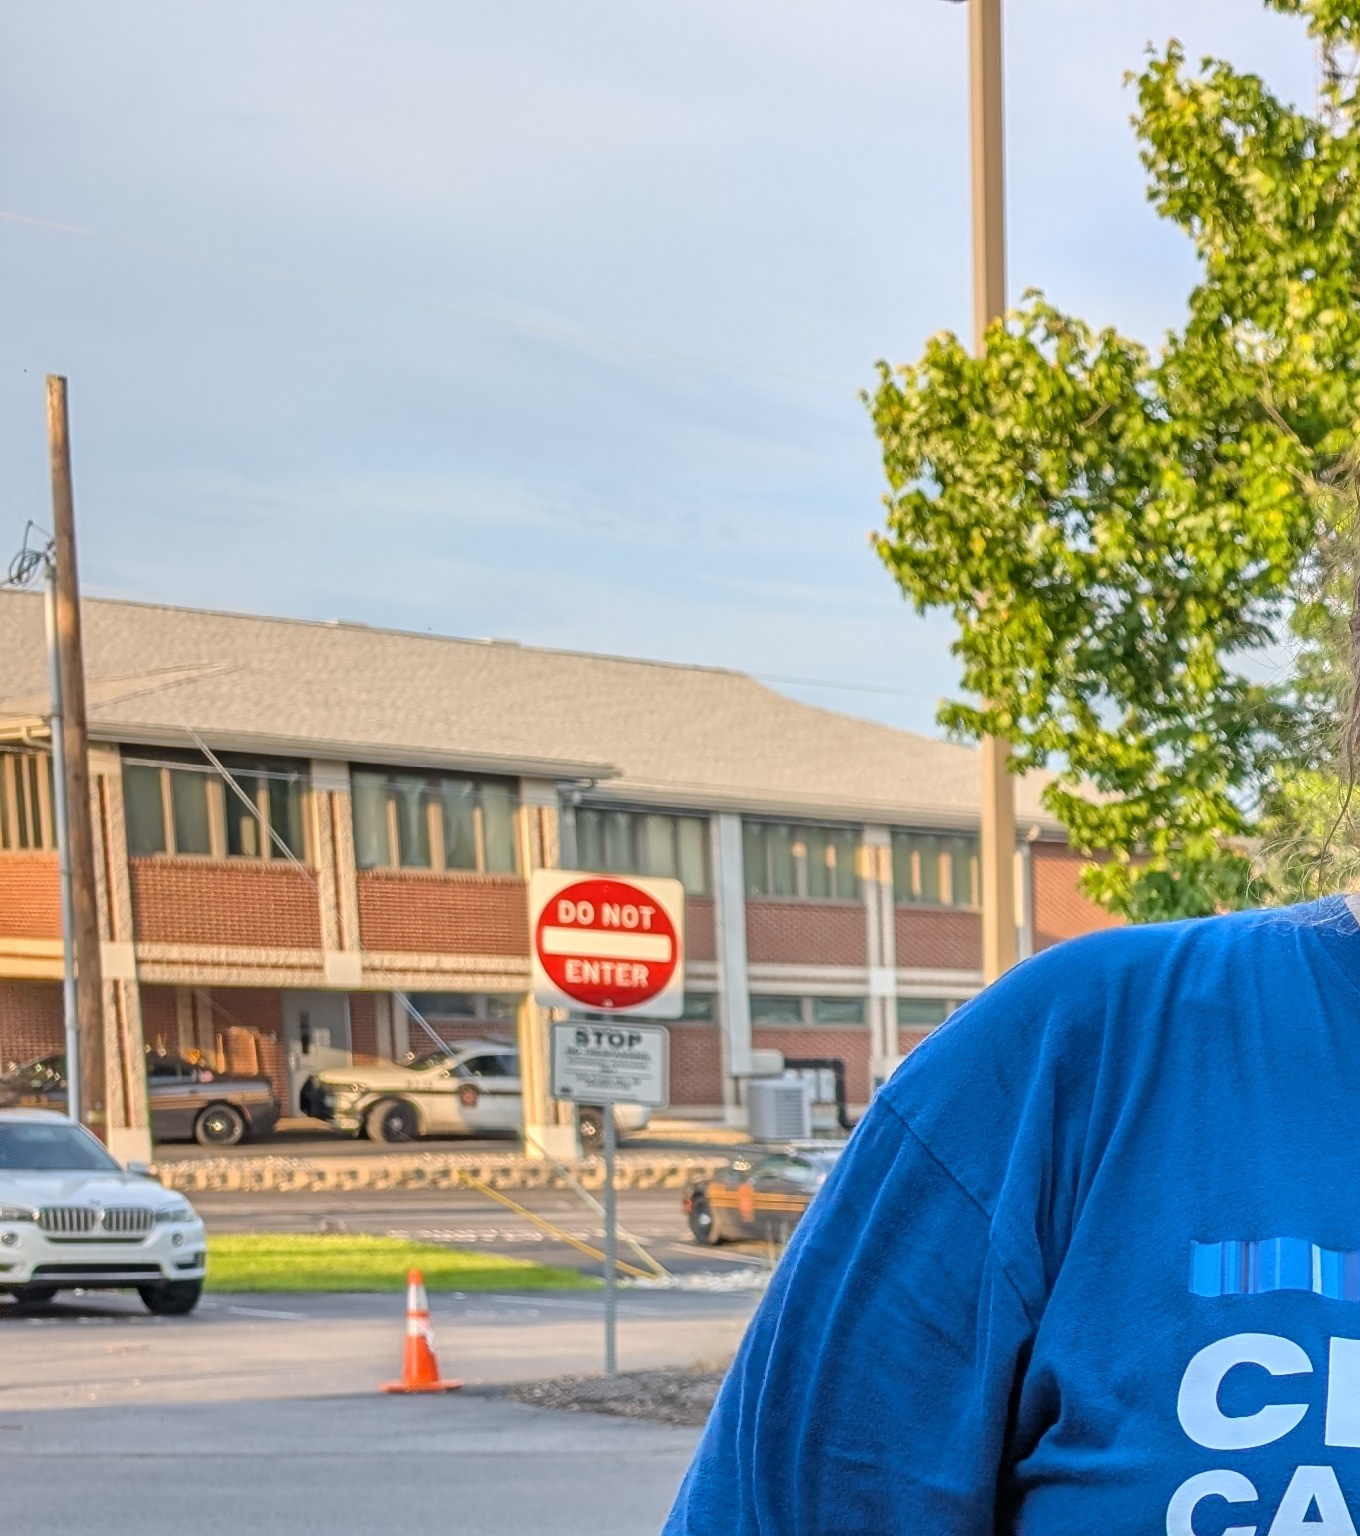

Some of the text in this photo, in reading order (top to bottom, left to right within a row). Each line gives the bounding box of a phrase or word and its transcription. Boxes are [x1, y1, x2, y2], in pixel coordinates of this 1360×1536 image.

[557, 899, 656, 931] DO NOT
[564, 958, 649, 988] ENTER
[575, 1030, 643, 1049] STOP
